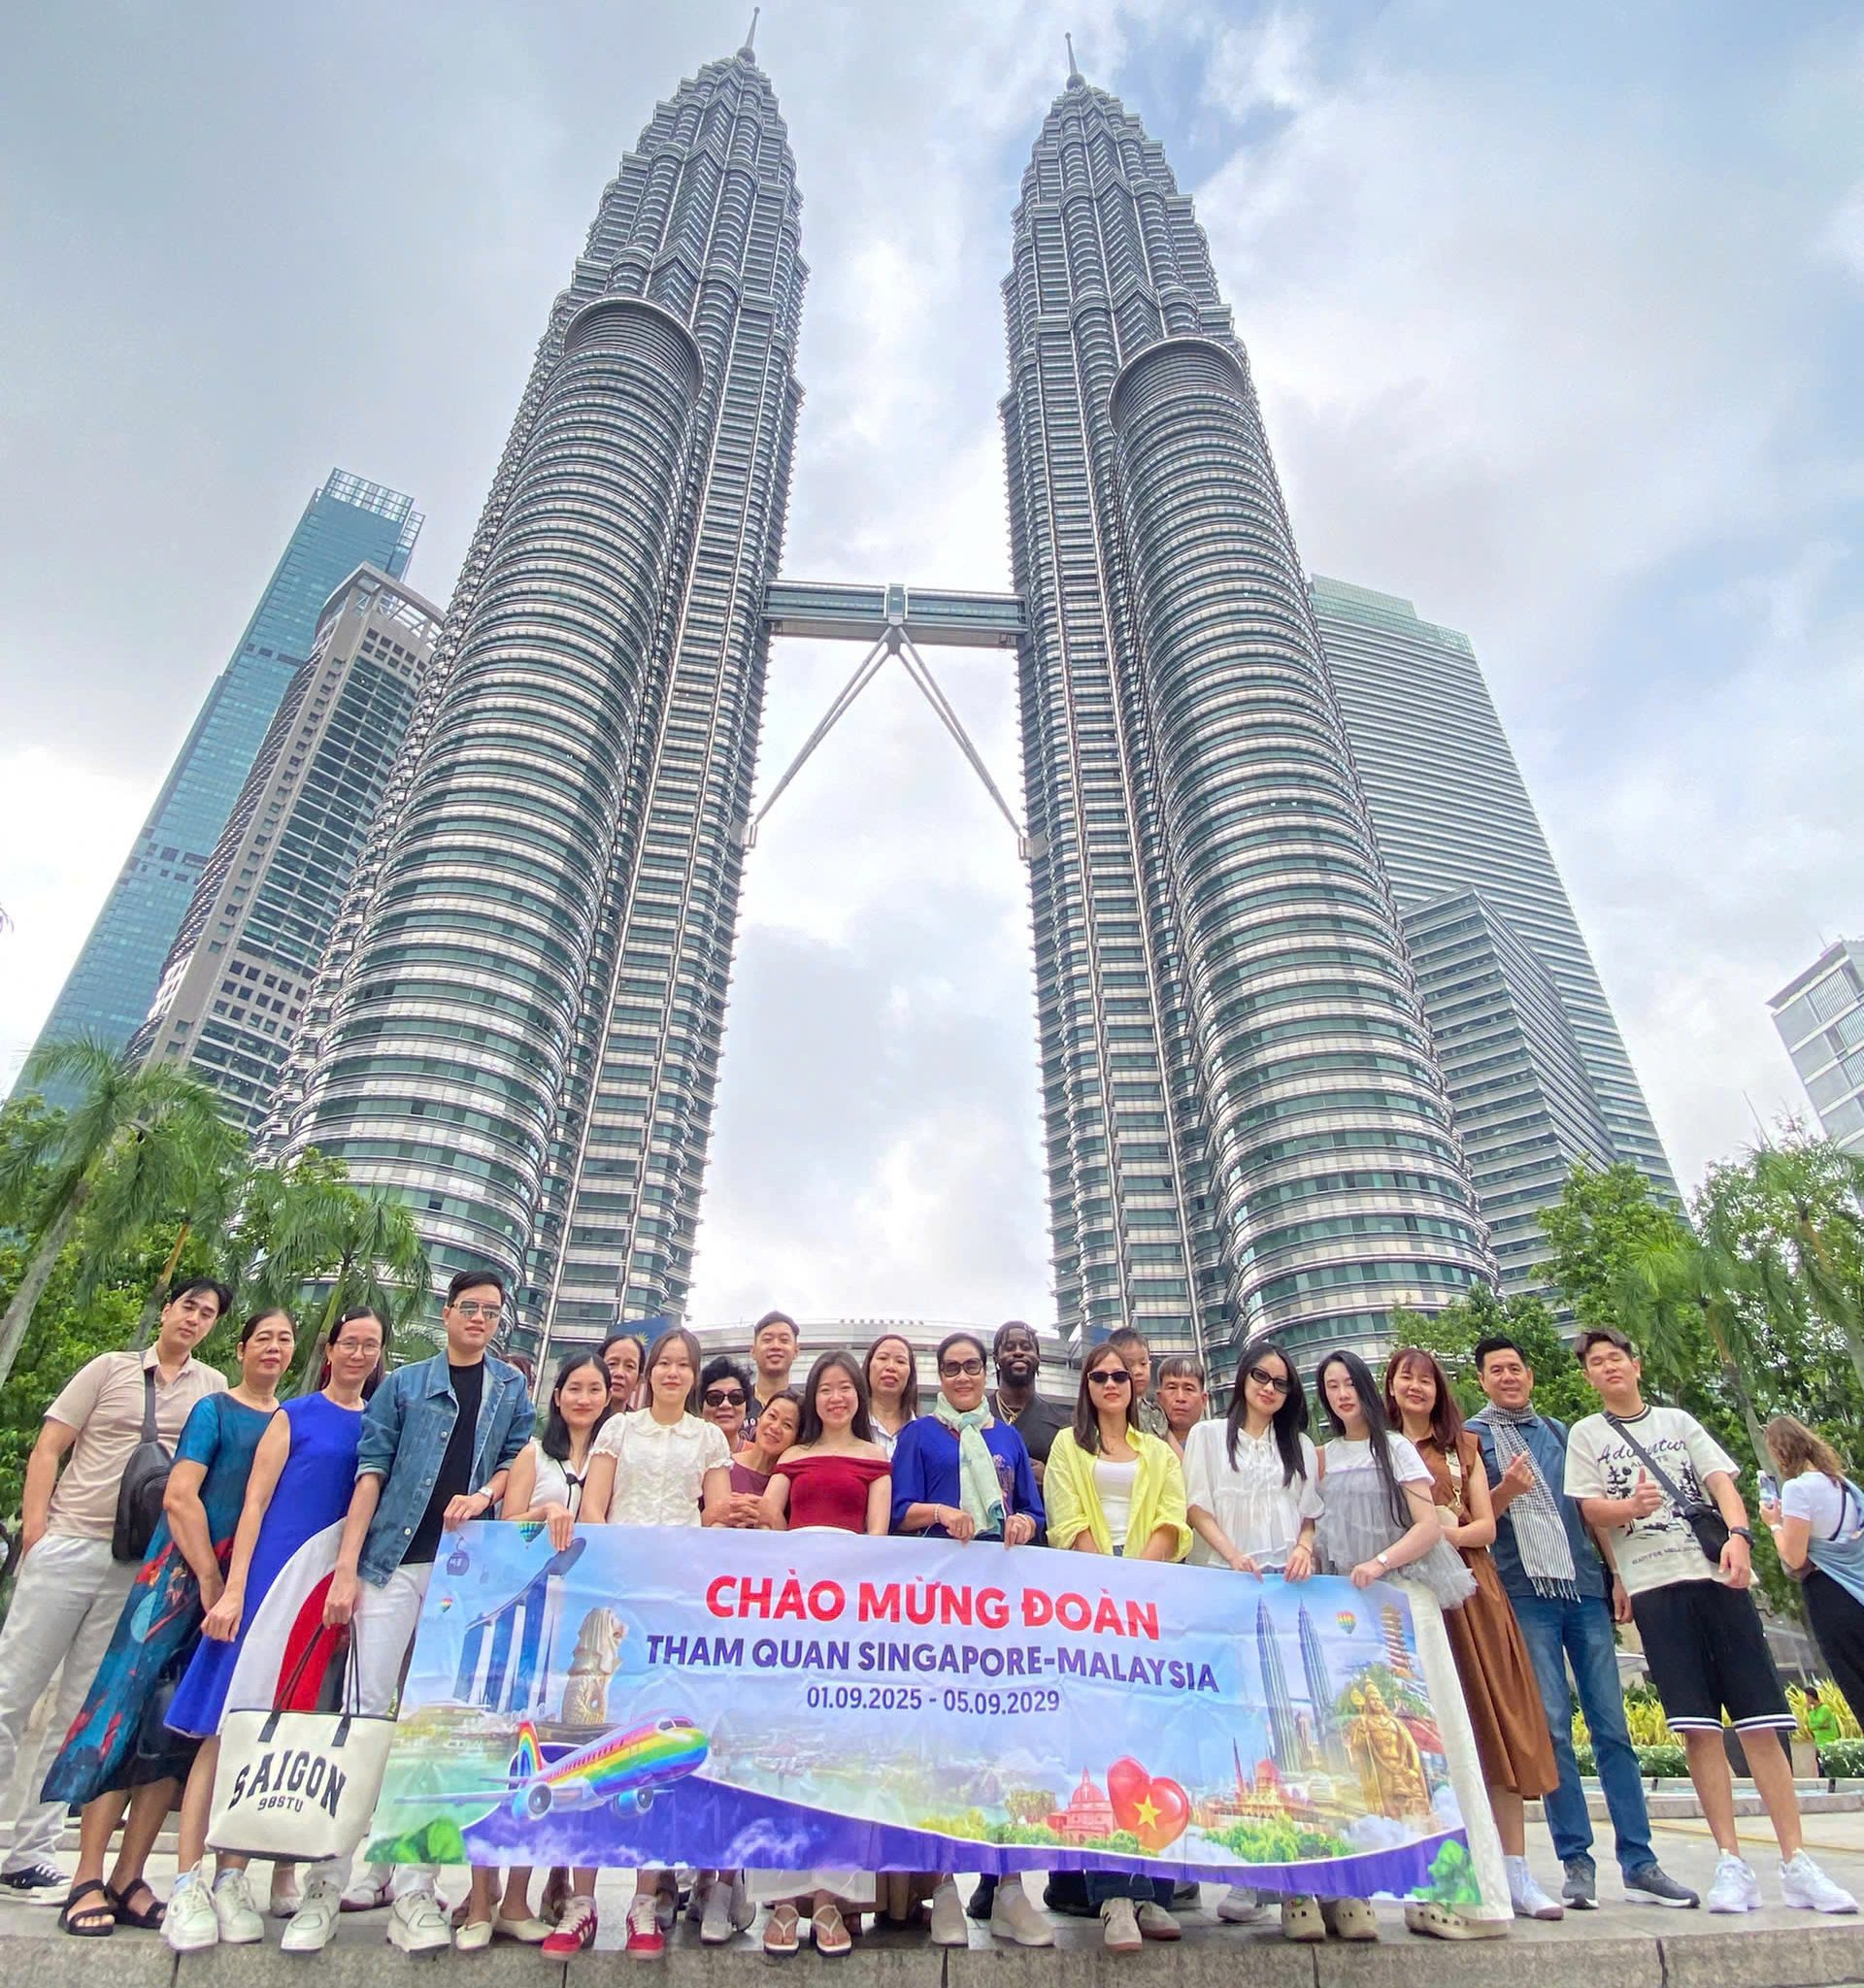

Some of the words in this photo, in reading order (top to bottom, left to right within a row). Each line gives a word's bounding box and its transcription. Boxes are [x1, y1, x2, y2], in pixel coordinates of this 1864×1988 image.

[706, 1570, 846, 1622] CHÀO
[857, 1575, 1011, 1630] MỪNG
[1021, 1588, 1160, 1640] ĐOÀN
[647, 1635, 745, 1667] THAM
[752, 1639, 850, 1670] QUAN
[857, 1641, 1219, 1693] SINGAPORE-MALAYSIA
[807, 1686, 922, 1709] 01.09.2025
[944, 1689, 1060, 1715] 05.09.2029
[227, 1749, 348, 1819] SAIGON
